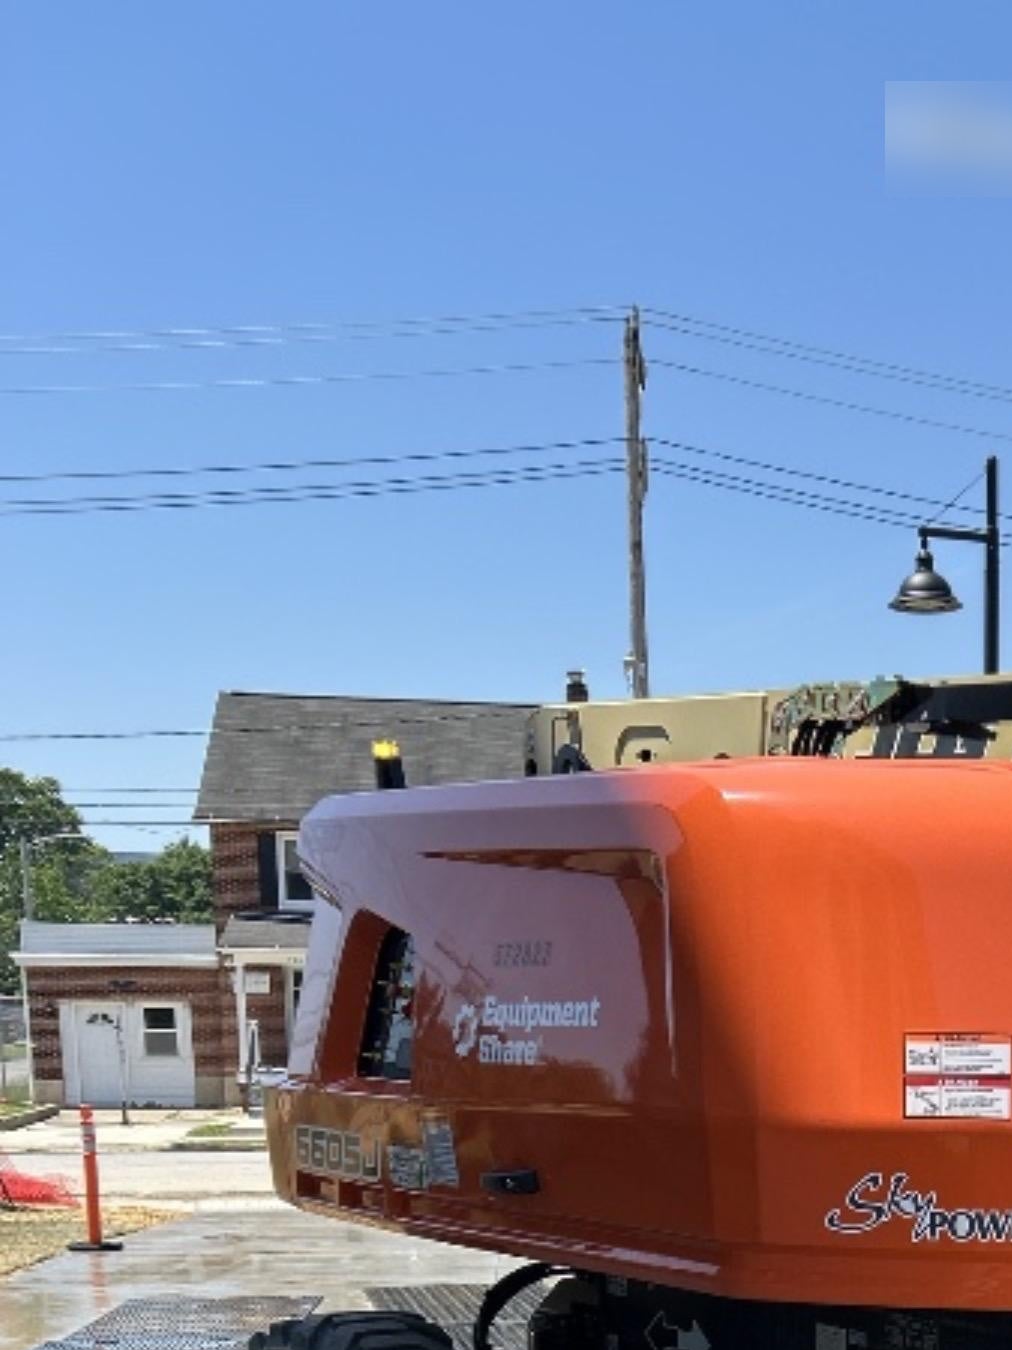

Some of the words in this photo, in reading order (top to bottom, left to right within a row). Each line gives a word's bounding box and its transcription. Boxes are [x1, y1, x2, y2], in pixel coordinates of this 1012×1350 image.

[481, 994, 601, 1032] Equipment
[478, 1035, 538, 1065] Share
[825, 1171, 936, 1242] Sky
